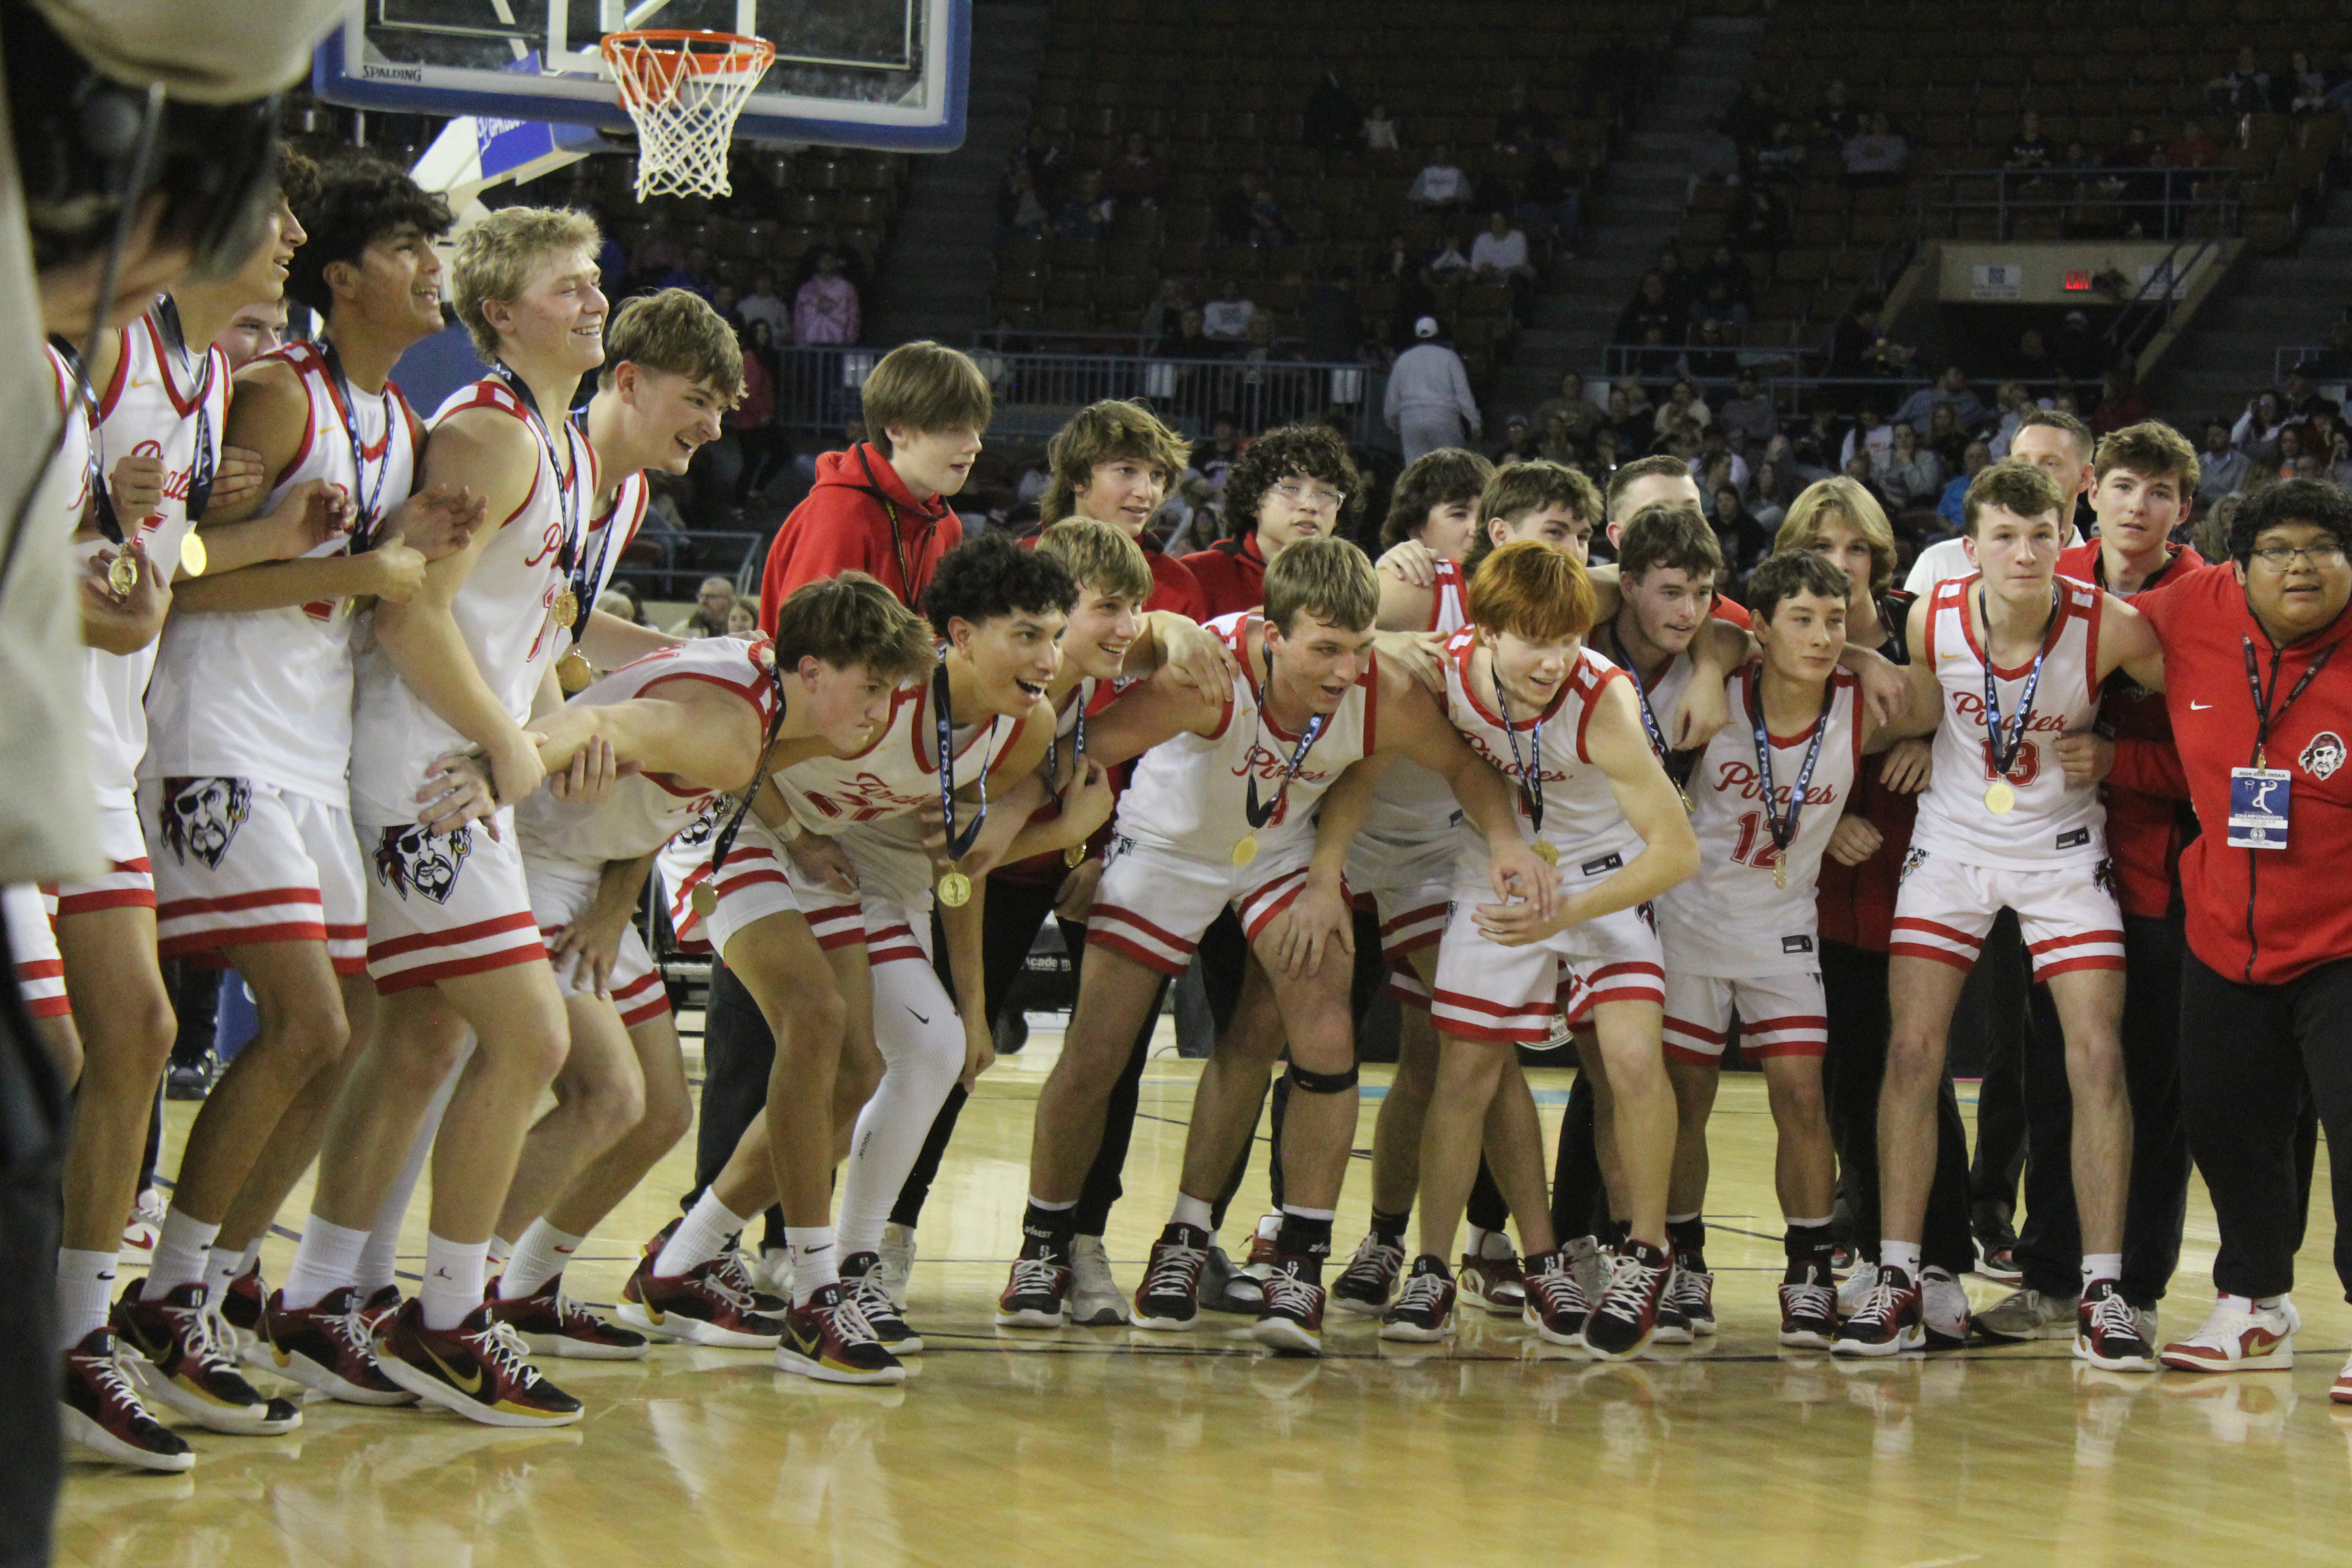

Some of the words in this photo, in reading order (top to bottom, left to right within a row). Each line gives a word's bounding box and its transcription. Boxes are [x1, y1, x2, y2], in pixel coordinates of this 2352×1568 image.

[363, 65, 421, 82] SPALDING
[1953, 691, 2068, 732] Piates
[941, 740, 952, 824] OSSAA
[1979, 737, 2040, 788] 13
[1608, 857, 1617, 865] M
[1729, 811, 1801, 870] 12
